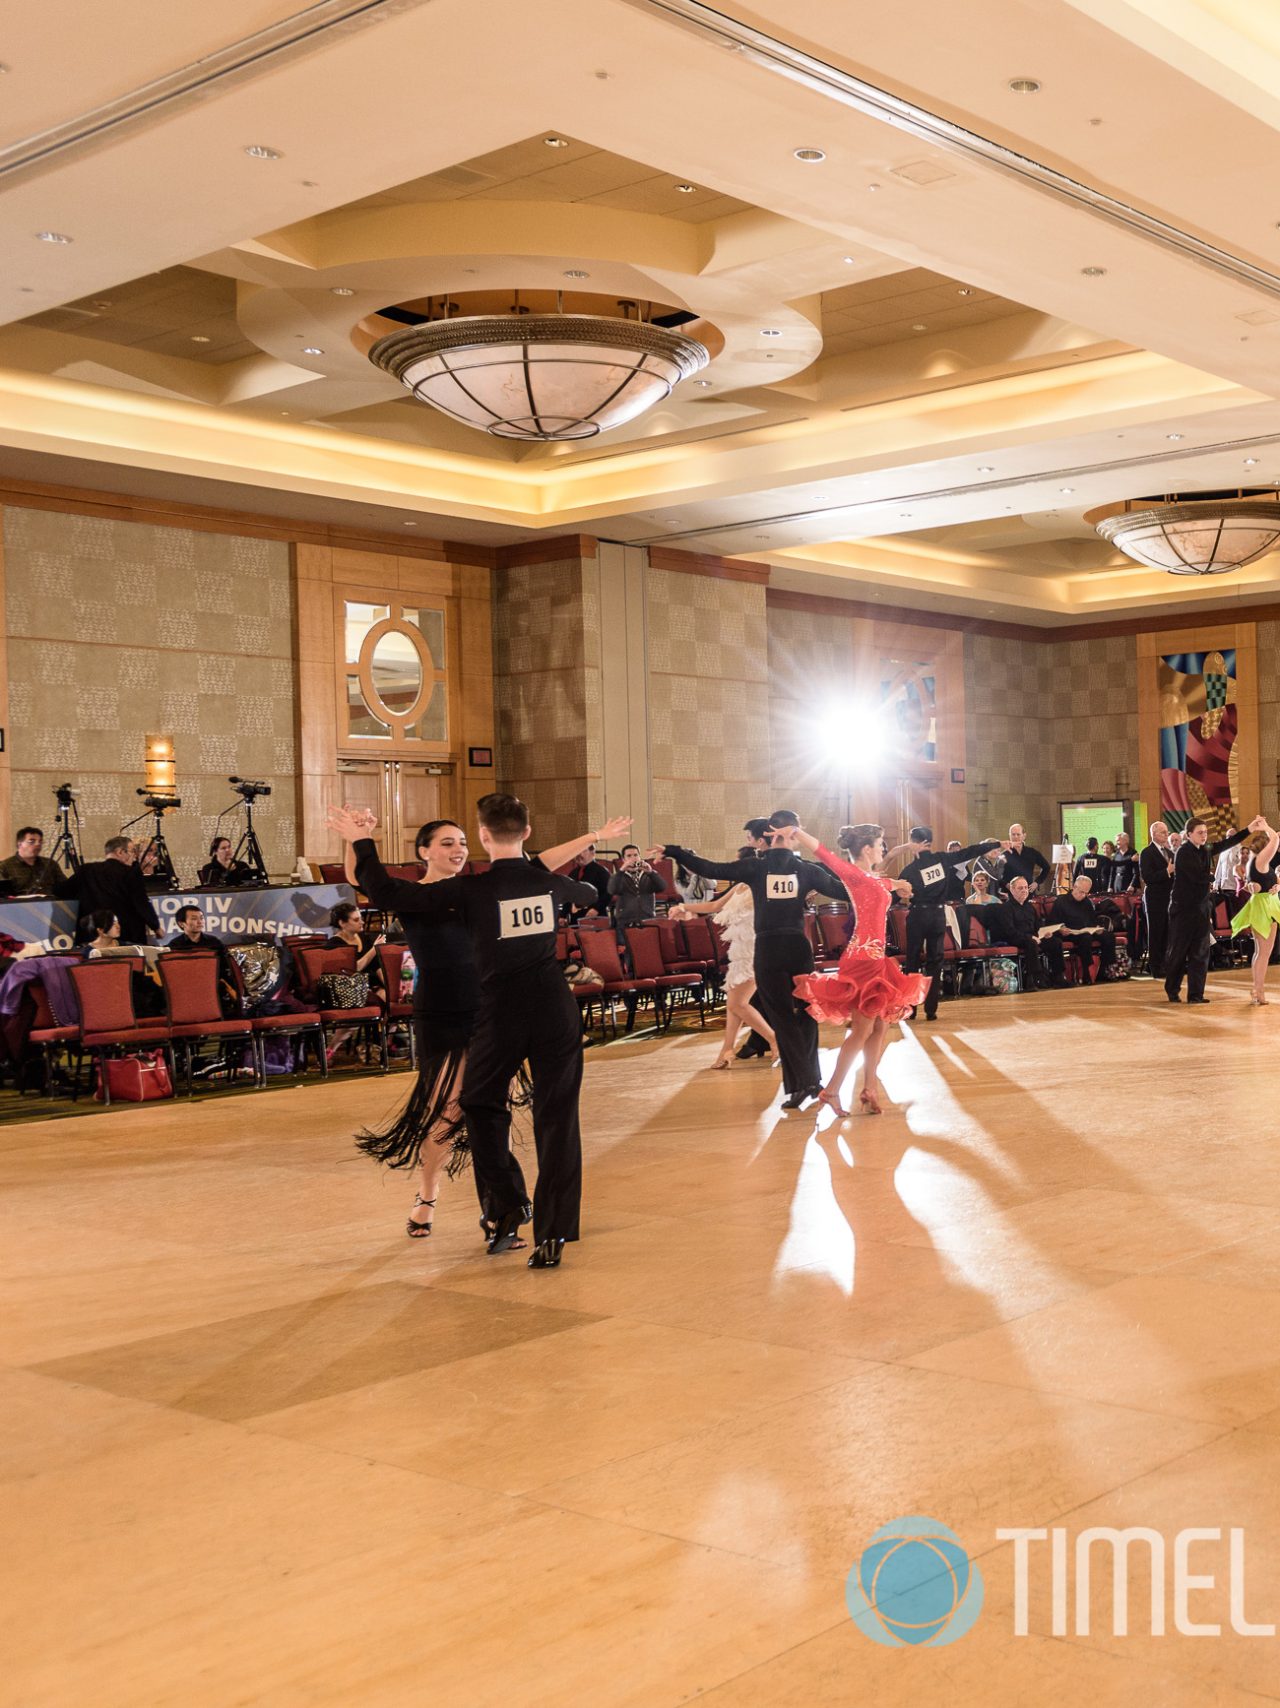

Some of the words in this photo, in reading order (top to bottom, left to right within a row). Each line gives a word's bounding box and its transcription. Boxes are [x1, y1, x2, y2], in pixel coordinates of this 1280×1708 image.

[926, 868, 941, 881] 370
[772, 880, 794, 894] 410
[206, 896, 232, 914] IV
[511, 905, 544, 928] 106
